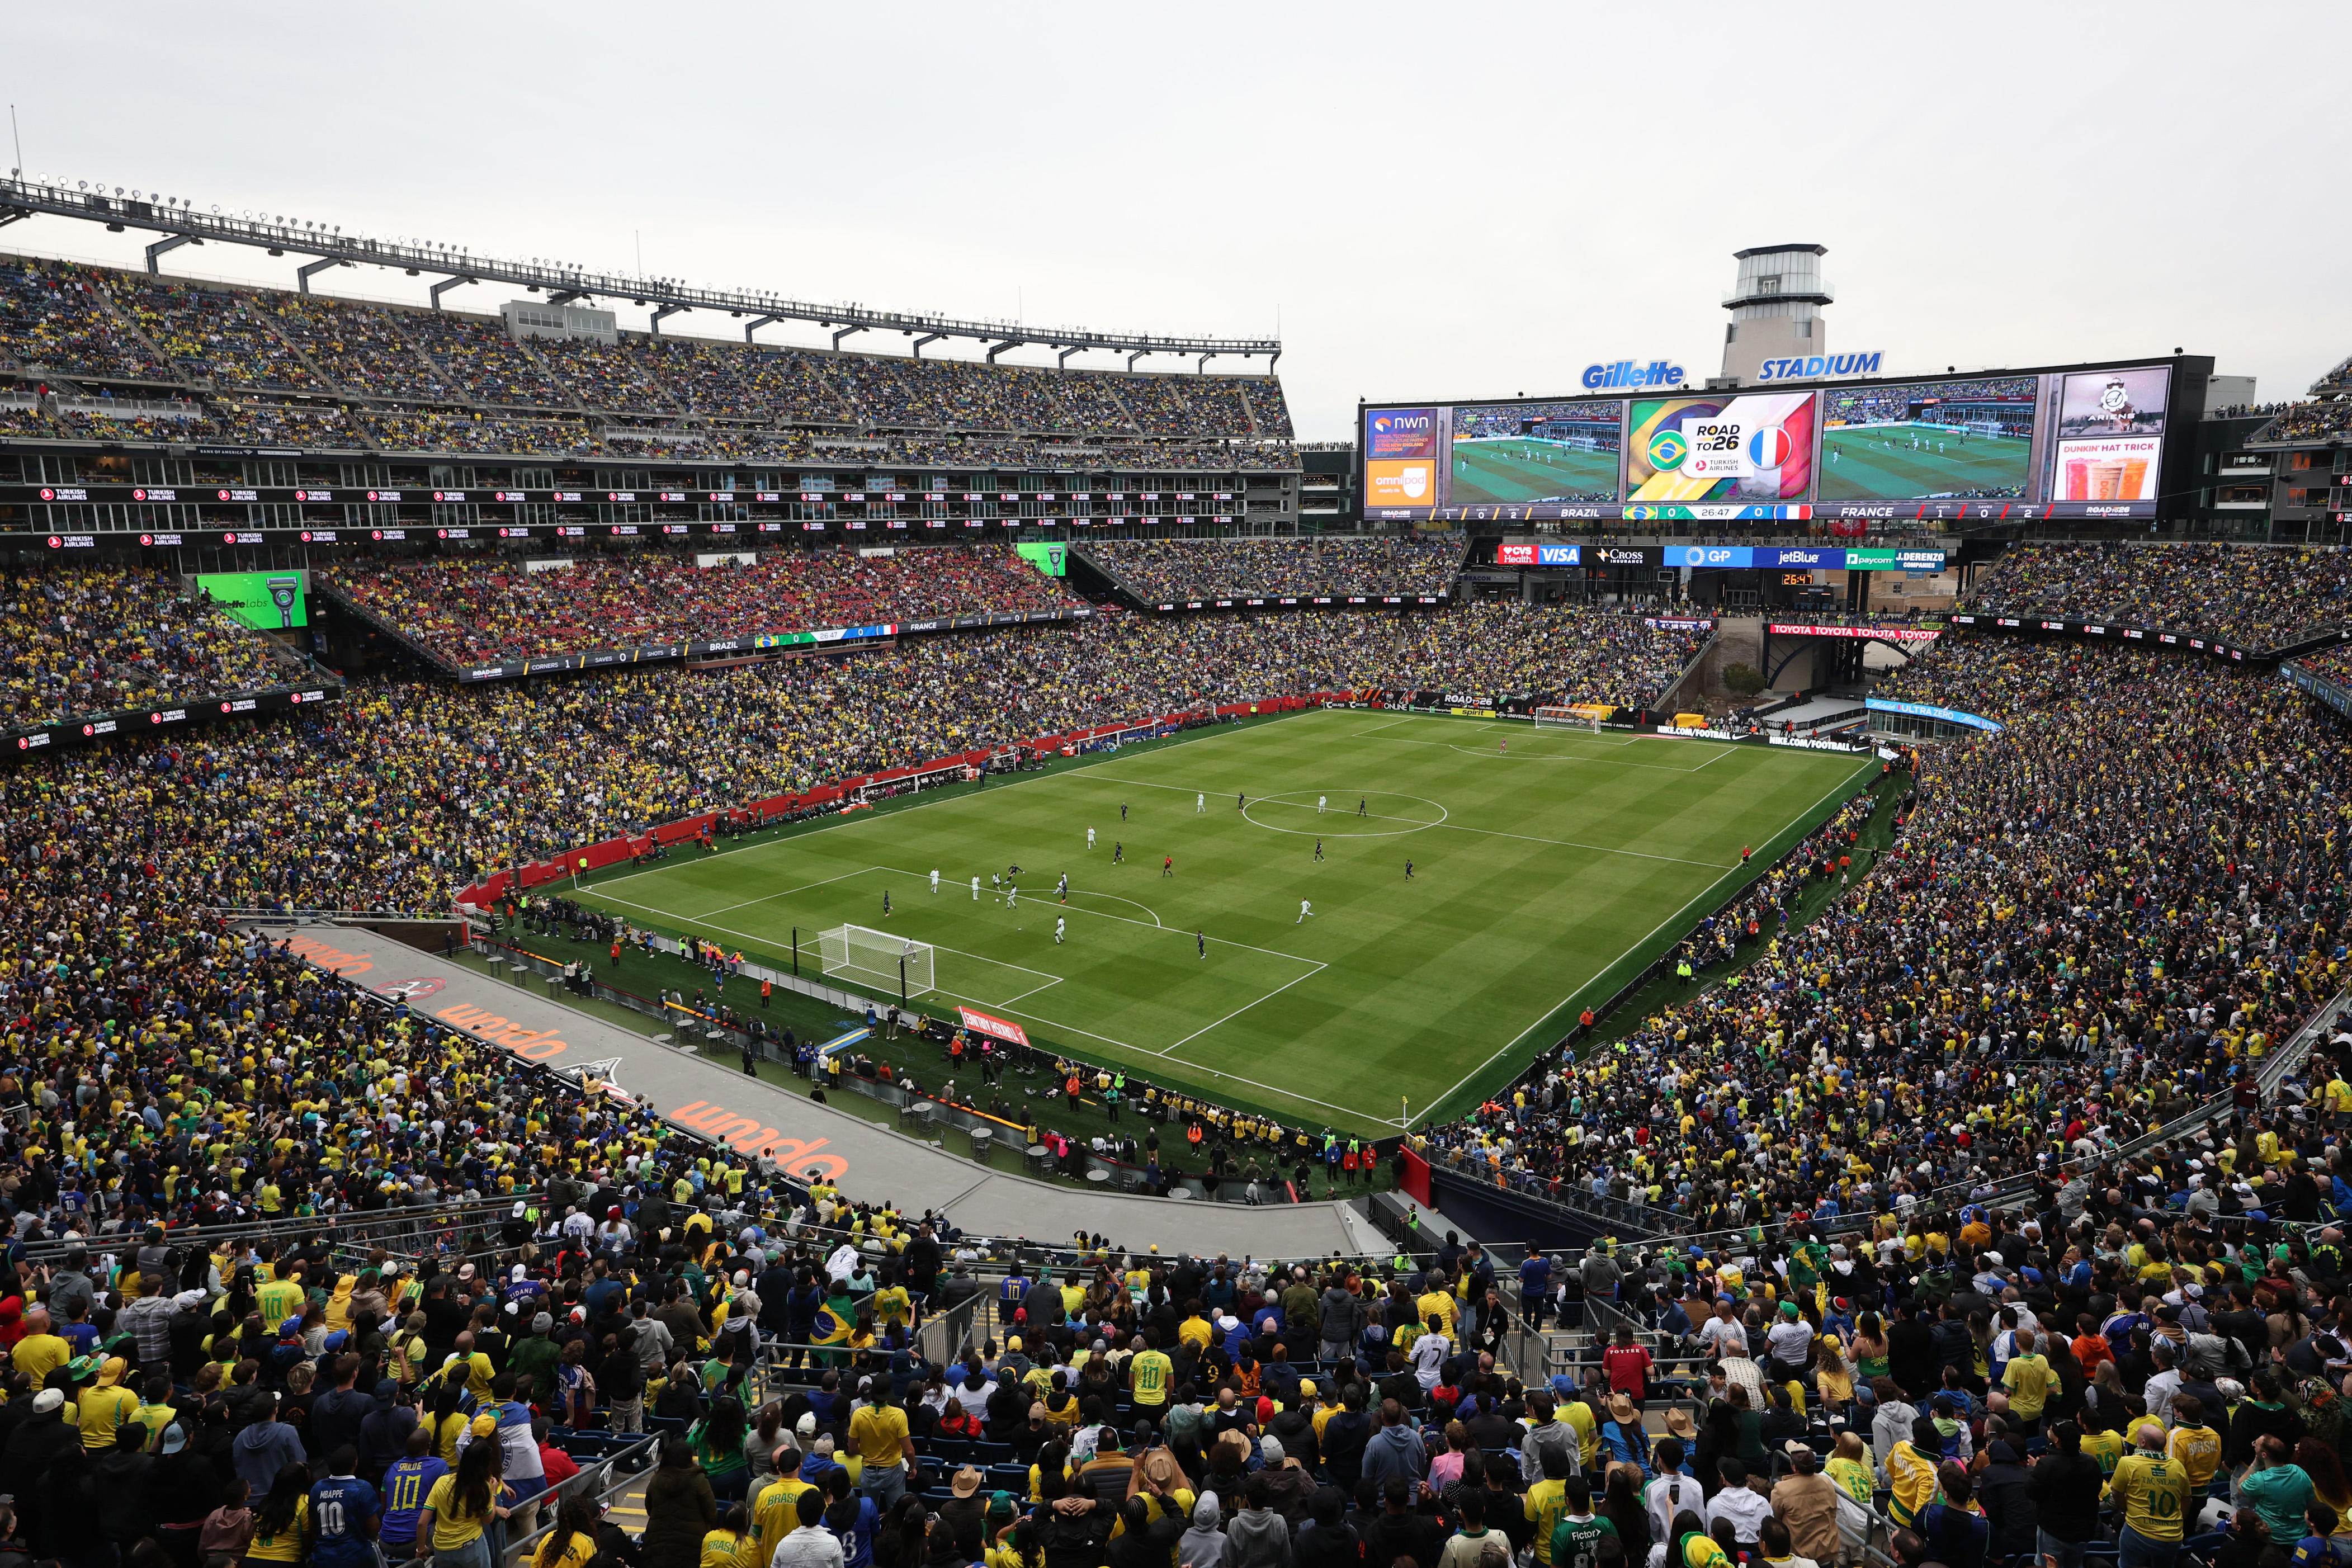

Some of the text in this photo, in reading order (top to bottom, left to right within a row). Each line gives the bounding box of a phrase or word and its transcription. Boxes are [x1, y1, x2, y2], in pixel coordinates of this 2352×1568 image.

[1581, 353, 1879, 389] Gillette STADIUM
[2087, 412, 2136, 421] ARIENS
[1395, 417, 1428, 429] nwn
[1697, 424, 1740, 436] ROAD
[1696, 442, 1711, 451] TO
[1376, 475, 1424, 485] omnipod
[1561, 509, 1600, 517] BRAZIL
[1668, 508, 1675, 517] 0
[1754, 508, 1763, 517] 0
[1841, 507, 1894, 517] FRANCE
[1938, 509, 1943, 518] 1
[1980, 509, 1989, 518] 0
[1541, 549, 1578, 562] VISA
[1778, 551, 1819, 565] jetBlue
[1783, 574, 1813, 584] 26:47
[858, 627, 864, 636] 0
[910, 622, 937, 631] FRANCE
[820, 631, 838, 640] 26:47
[1774, 625, 1939, 640] TOYOTA TOYOTA TOYOTA TOYOTA
[793, 635, 799, 643] 0
[710, 641, 738, 651] BRAZIL
[620, 653, 626, 662] 0
[671, 648, 677, 657] 2
[532, 662, 558, 670] CORNERS
[565, 660, 570, 668] 1
[1444, 695, 1493, 706] ROAD 26
[1371, 702, 1407, 711] BETONLINE
[1901, 705, 1932, 715] ULTRA
[1933, 709, 1954, 719] ZERO
[95, 725, 116, 734] AIRLINES
[1657, 726, 1731, 739] NIKE.COM/FOOTBALL
[29, 733, 49, 742] TURKISH
[30, 738, 50, 747] AIRLINES
[1769, 736, 1850, 752] NIKE.COM/FOOTBALL
[964, 1011, 1019, 1042] TURKISH AIRLINES
[436, 1004, 568, 1060] optum
[670, 1100, 848, 1181] optum
[65, 1199, 75, 1210] 10
[936, 1224, 942, 1234] 10
[840, 1253, 847, 1263] 7
[509, 1287, 533, 1299] ZIDANE
[1008, 1284, 1020, 1299] 10
[264, 1297, 282, 1320] 10
[1430, 1347, 1441, 1367] 7
[1142, 1366, 1159, 1389] 10
[1208, 1366, 1219, 1383] 9
[2188, 1439, 2218, 1456] BRASIL
[2096, 1451, 2118, 1472] 10
[319, 1489, 344, 1499] MBAPPE
[390, 1473, 422, 1511] 10
[2148, 1490, 2176, 1518] 10
[317, 1501, 345, 1536] 10
[1572, 1529, 1595, 1542] Fictor
